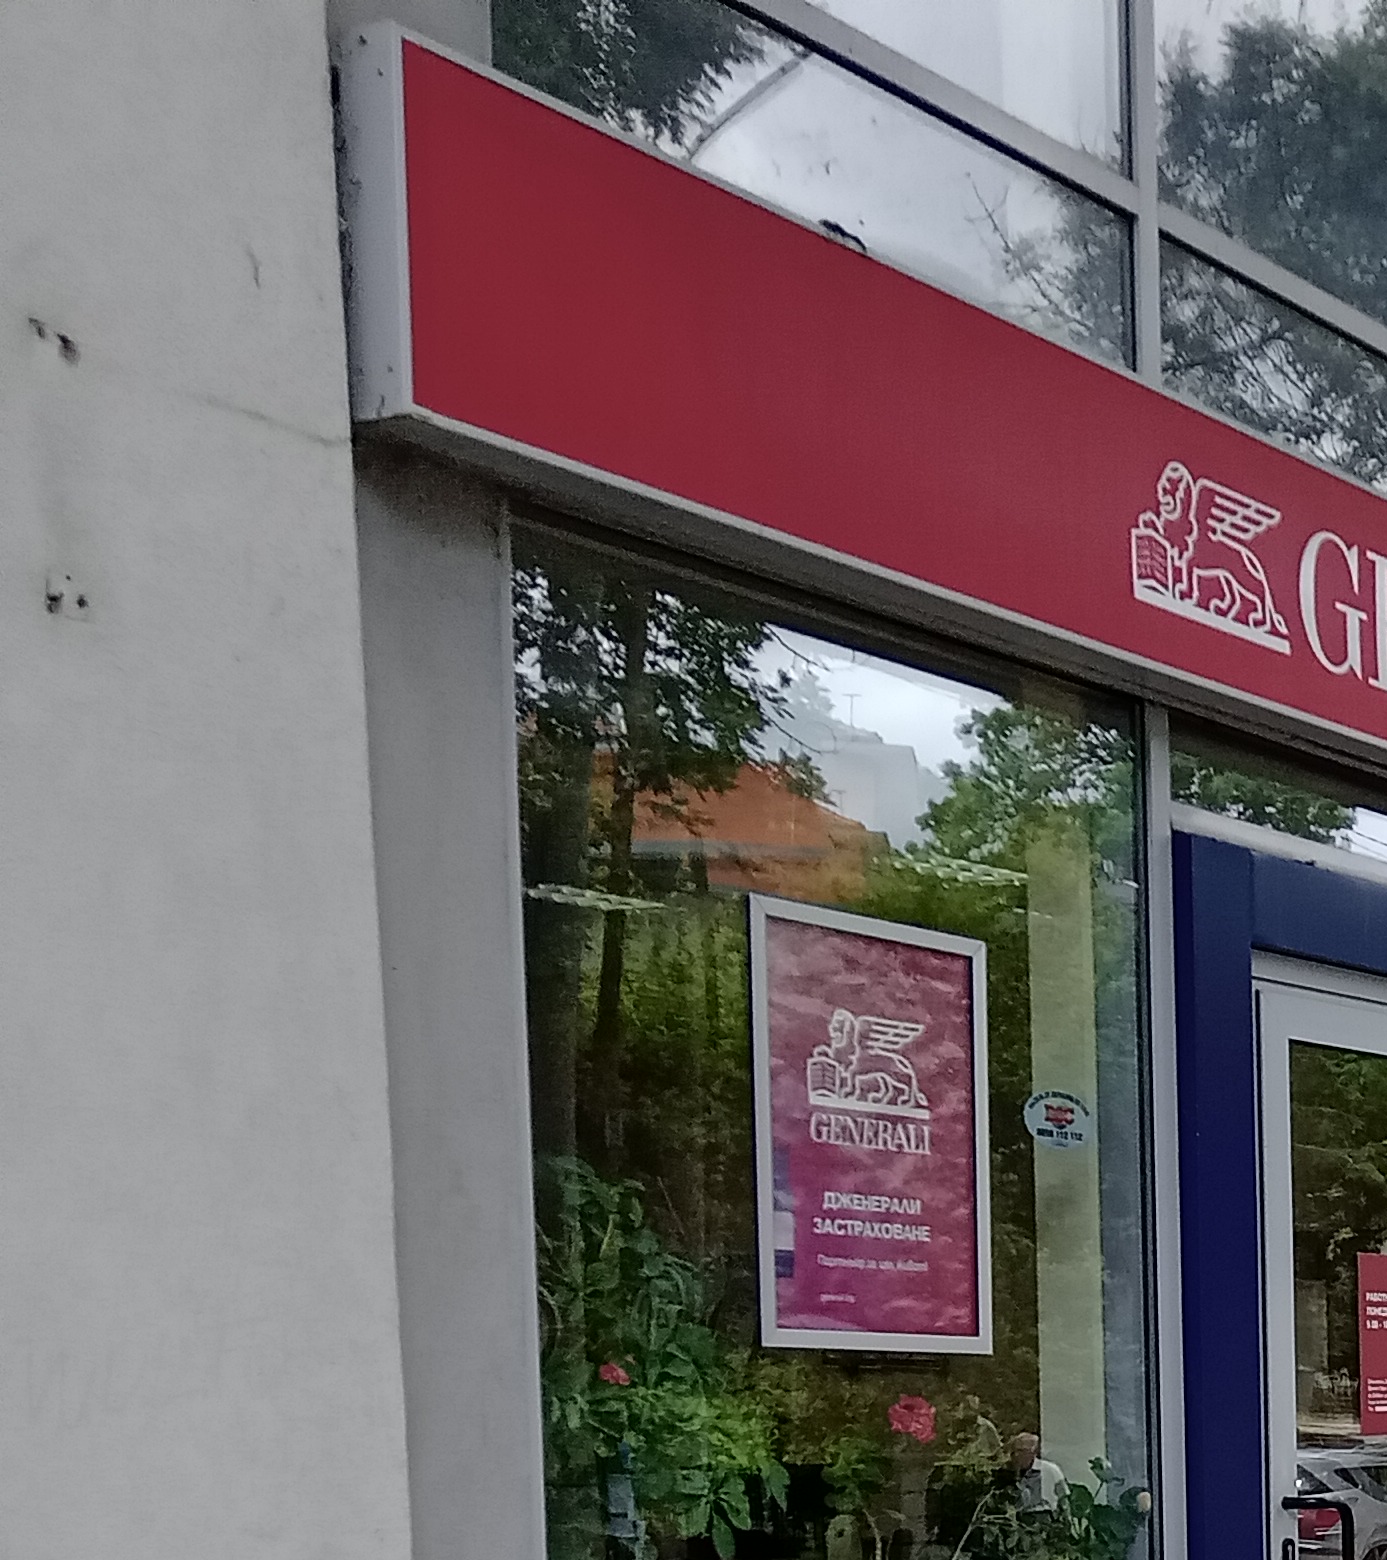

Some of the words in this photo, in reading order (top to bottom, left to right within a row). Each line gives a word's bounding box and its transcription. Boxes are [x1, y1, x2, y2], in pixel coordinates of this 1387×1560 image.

[809, 1111, 932, 1155] GENERALI
[822, 1191, 922, 1215] ДЖЕНЕРАЛИ
[812, 1217, 932, 1242] ЗАСТРАХОВАНЕ
